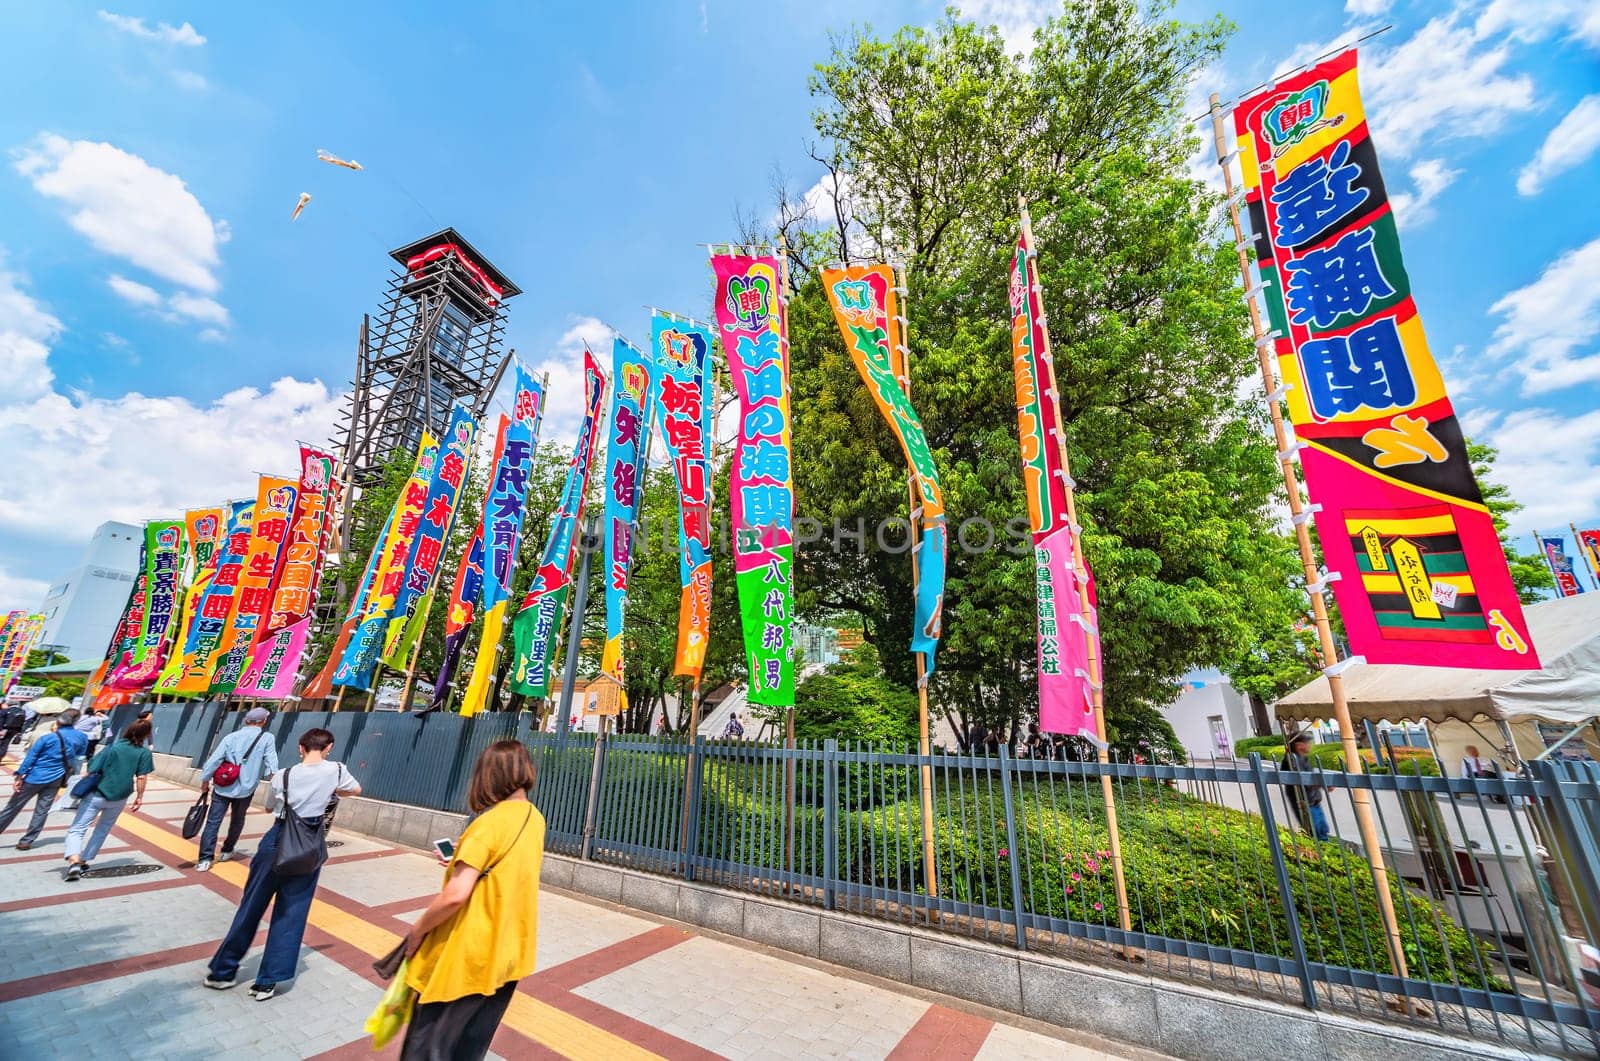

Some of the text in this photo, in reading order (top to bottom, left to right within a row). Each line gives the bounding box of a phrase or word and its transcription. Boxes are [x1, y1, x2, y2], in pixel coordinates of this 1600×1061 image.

[739, 288, 762, 312] 贈
[763, 559, 786, 690] 八代邦男
